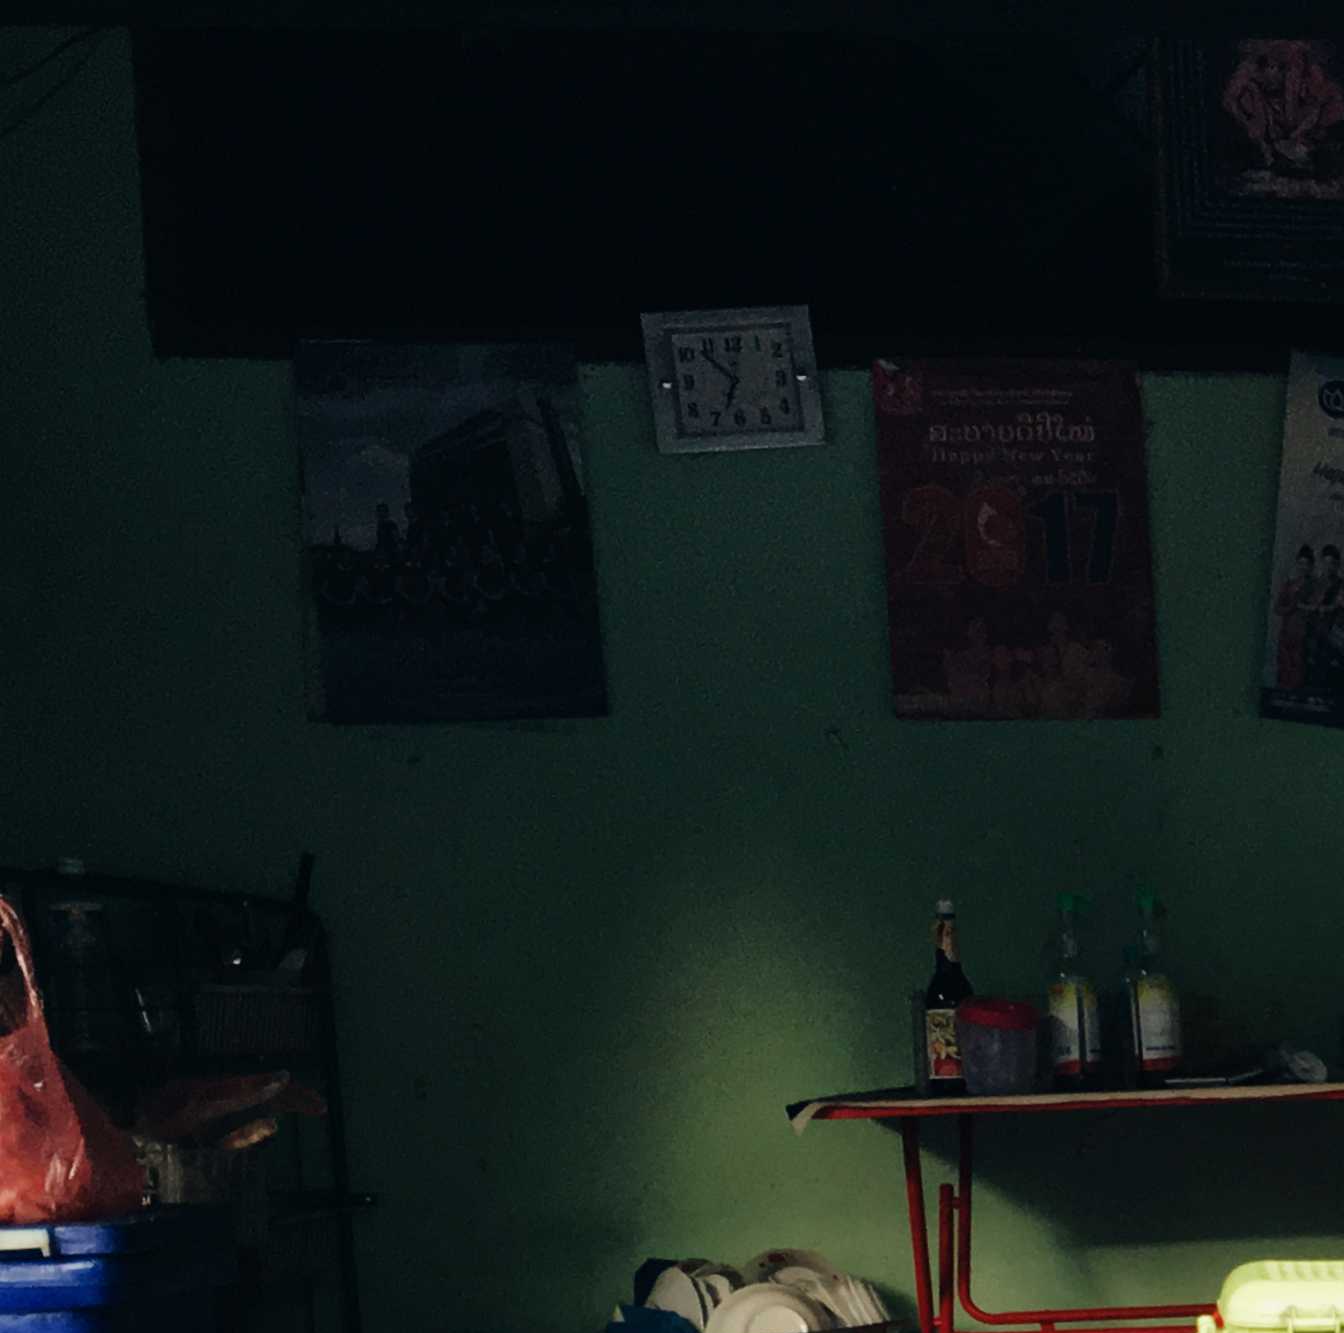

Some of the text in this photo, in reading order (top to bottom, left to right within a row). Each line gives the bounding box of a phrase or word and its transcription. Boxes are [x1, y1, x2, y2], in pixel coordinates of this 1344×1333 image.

[725, 336, 743, 353] 12
[679, 346, 696, 363] 10
[710, 411, 721, 427] 7
[734, 408, 747, 426] 6
